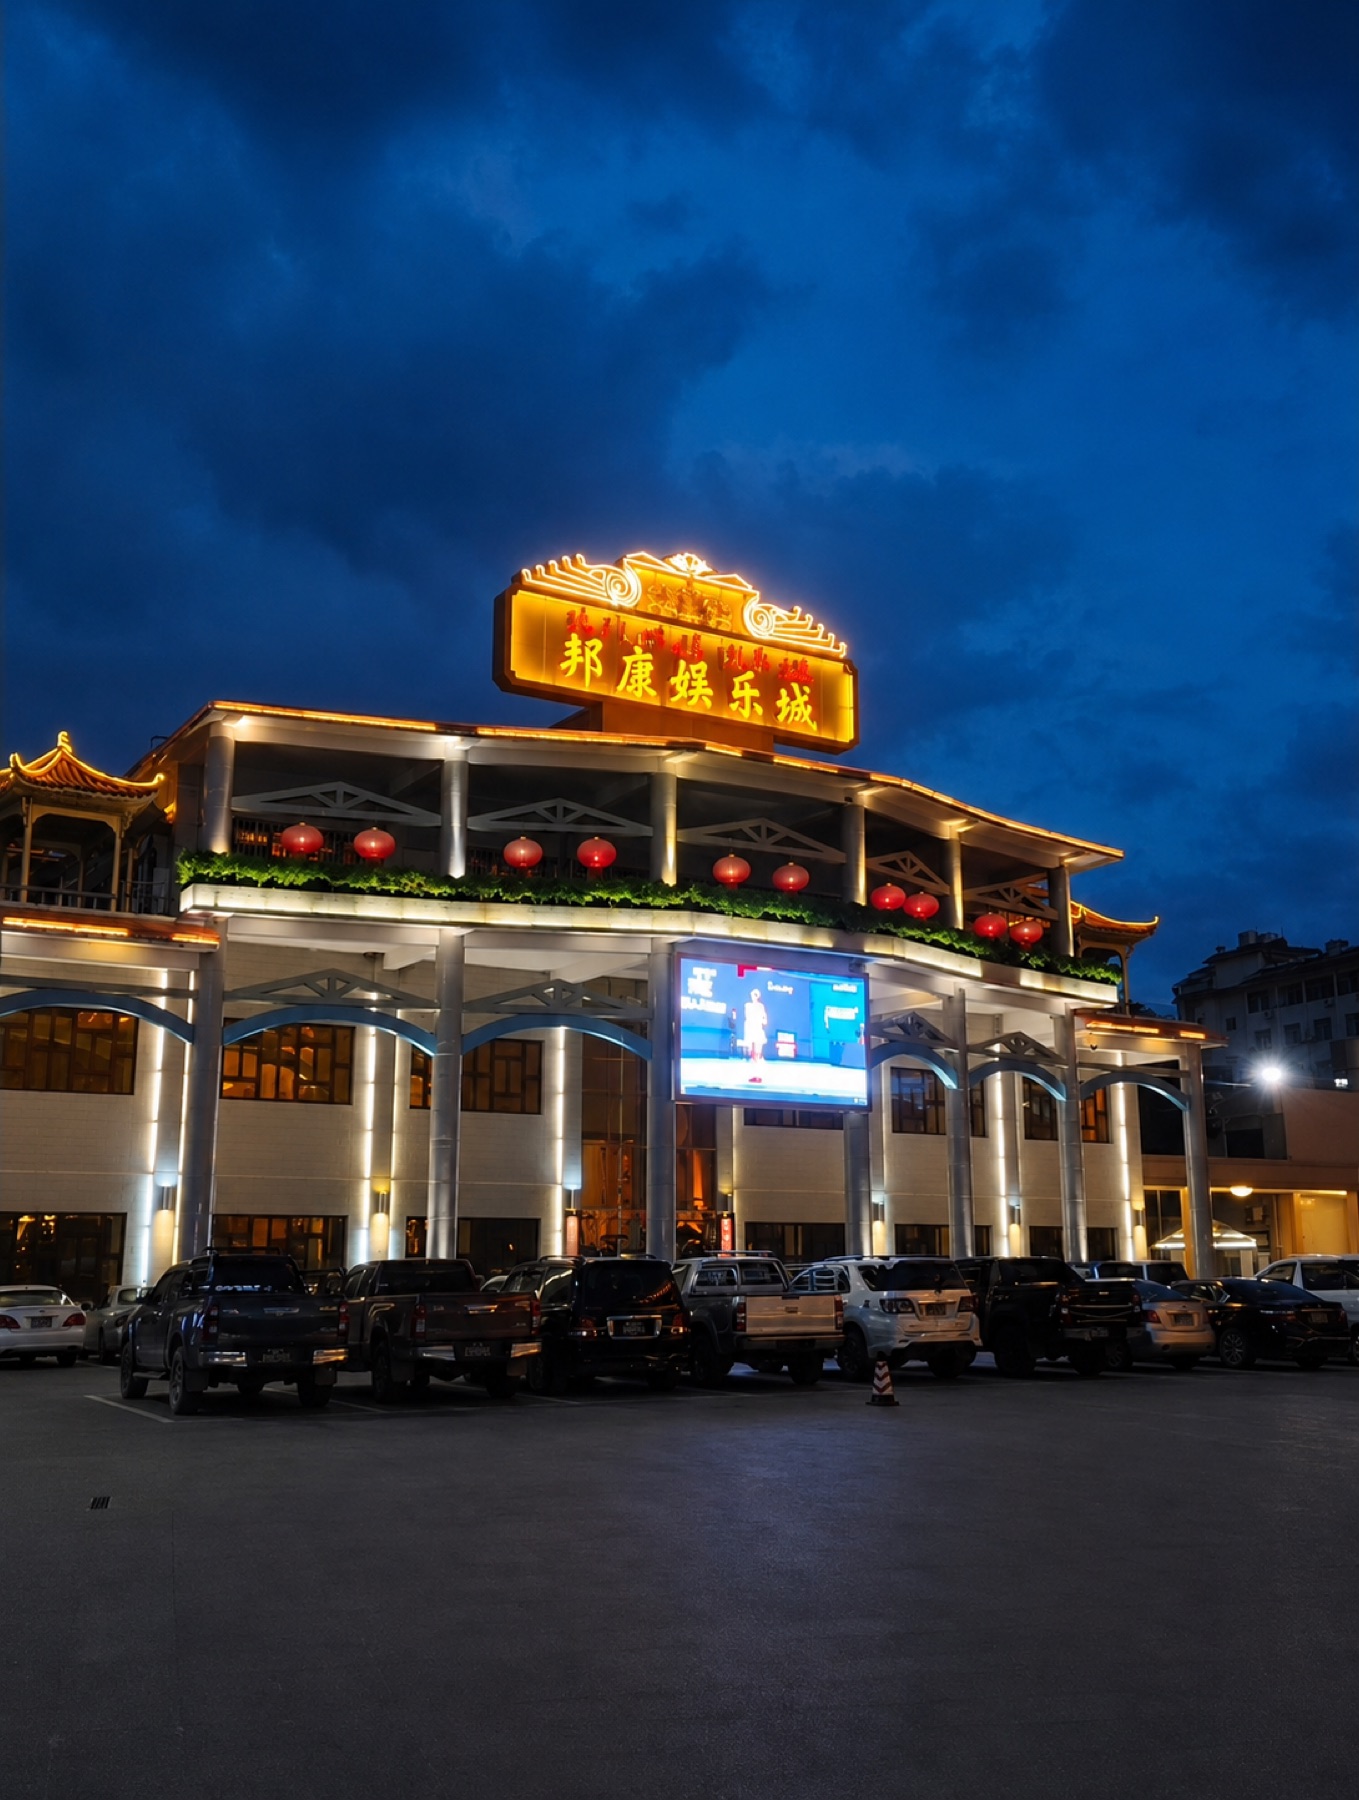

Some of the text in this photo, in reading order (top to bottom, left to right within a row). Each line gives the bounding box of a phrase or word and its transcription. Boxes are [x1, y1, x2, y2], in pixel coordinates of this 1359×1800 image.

[560, 633, 817, 730] 邦康娱乐城
